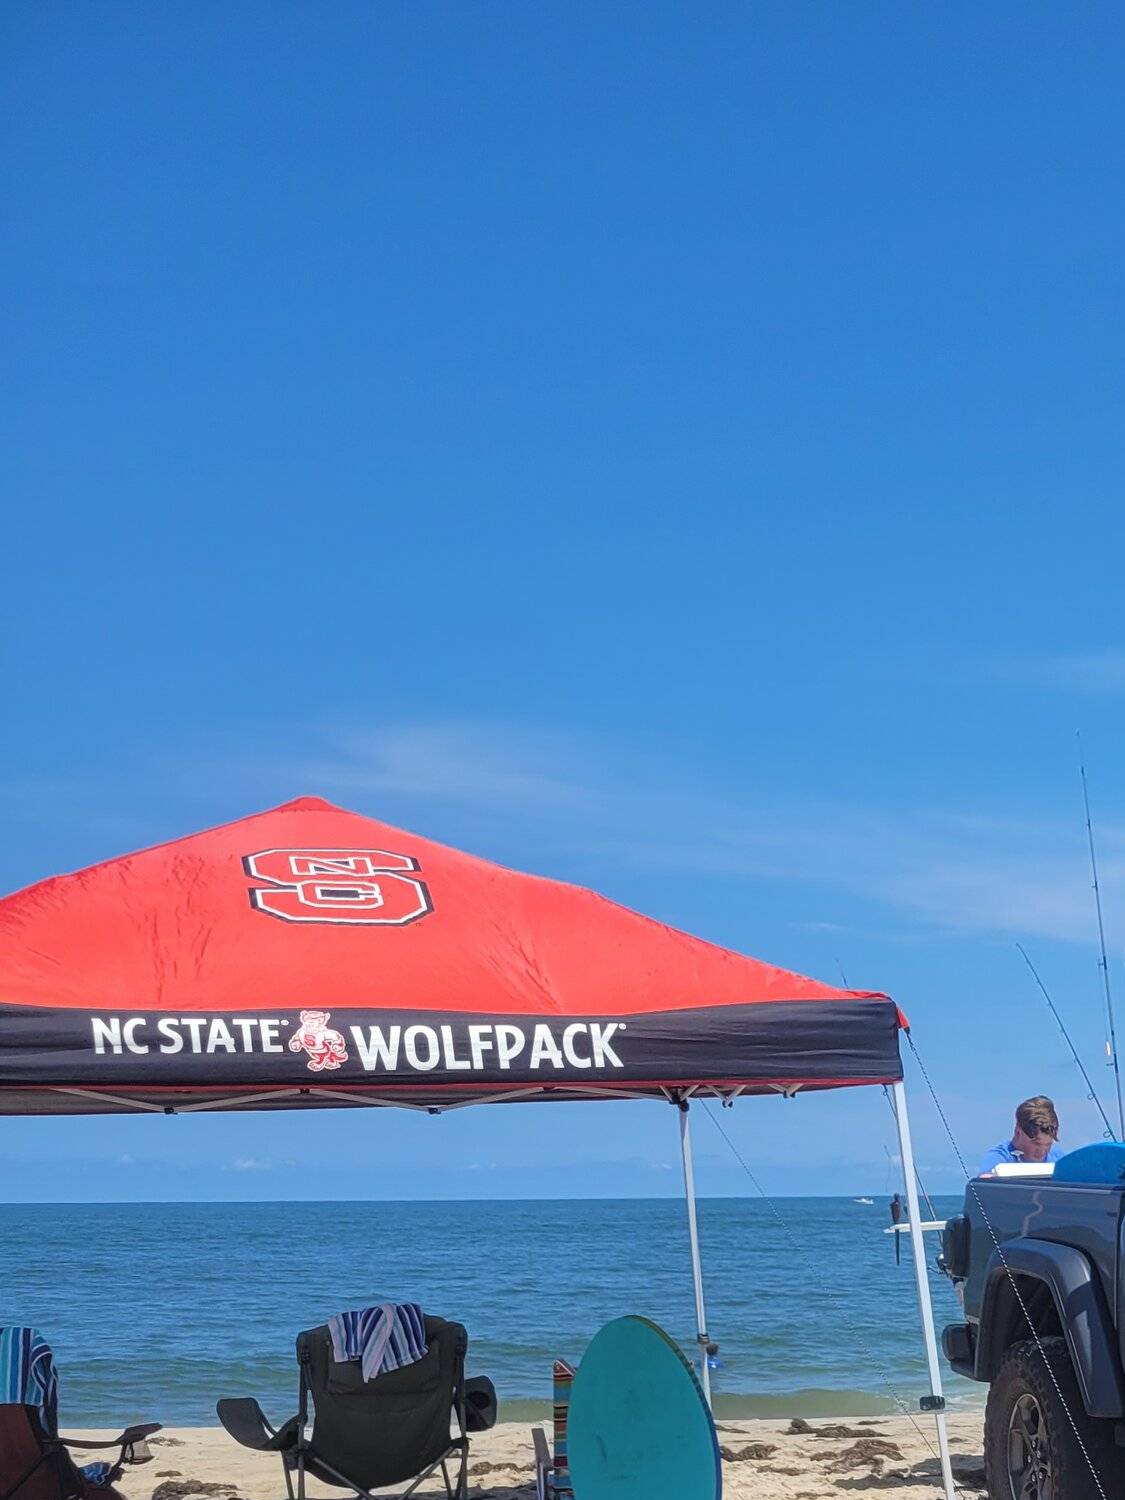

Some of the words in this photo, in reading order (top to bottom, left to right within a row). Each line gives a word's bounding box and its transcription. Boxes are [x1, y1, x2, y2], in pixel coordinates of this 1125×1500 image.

[90, 1017, 149, 1055] NC
[157, 1017, 285, 1055] STATE
[349, 1023, 625, 1071] WOLFPACK
